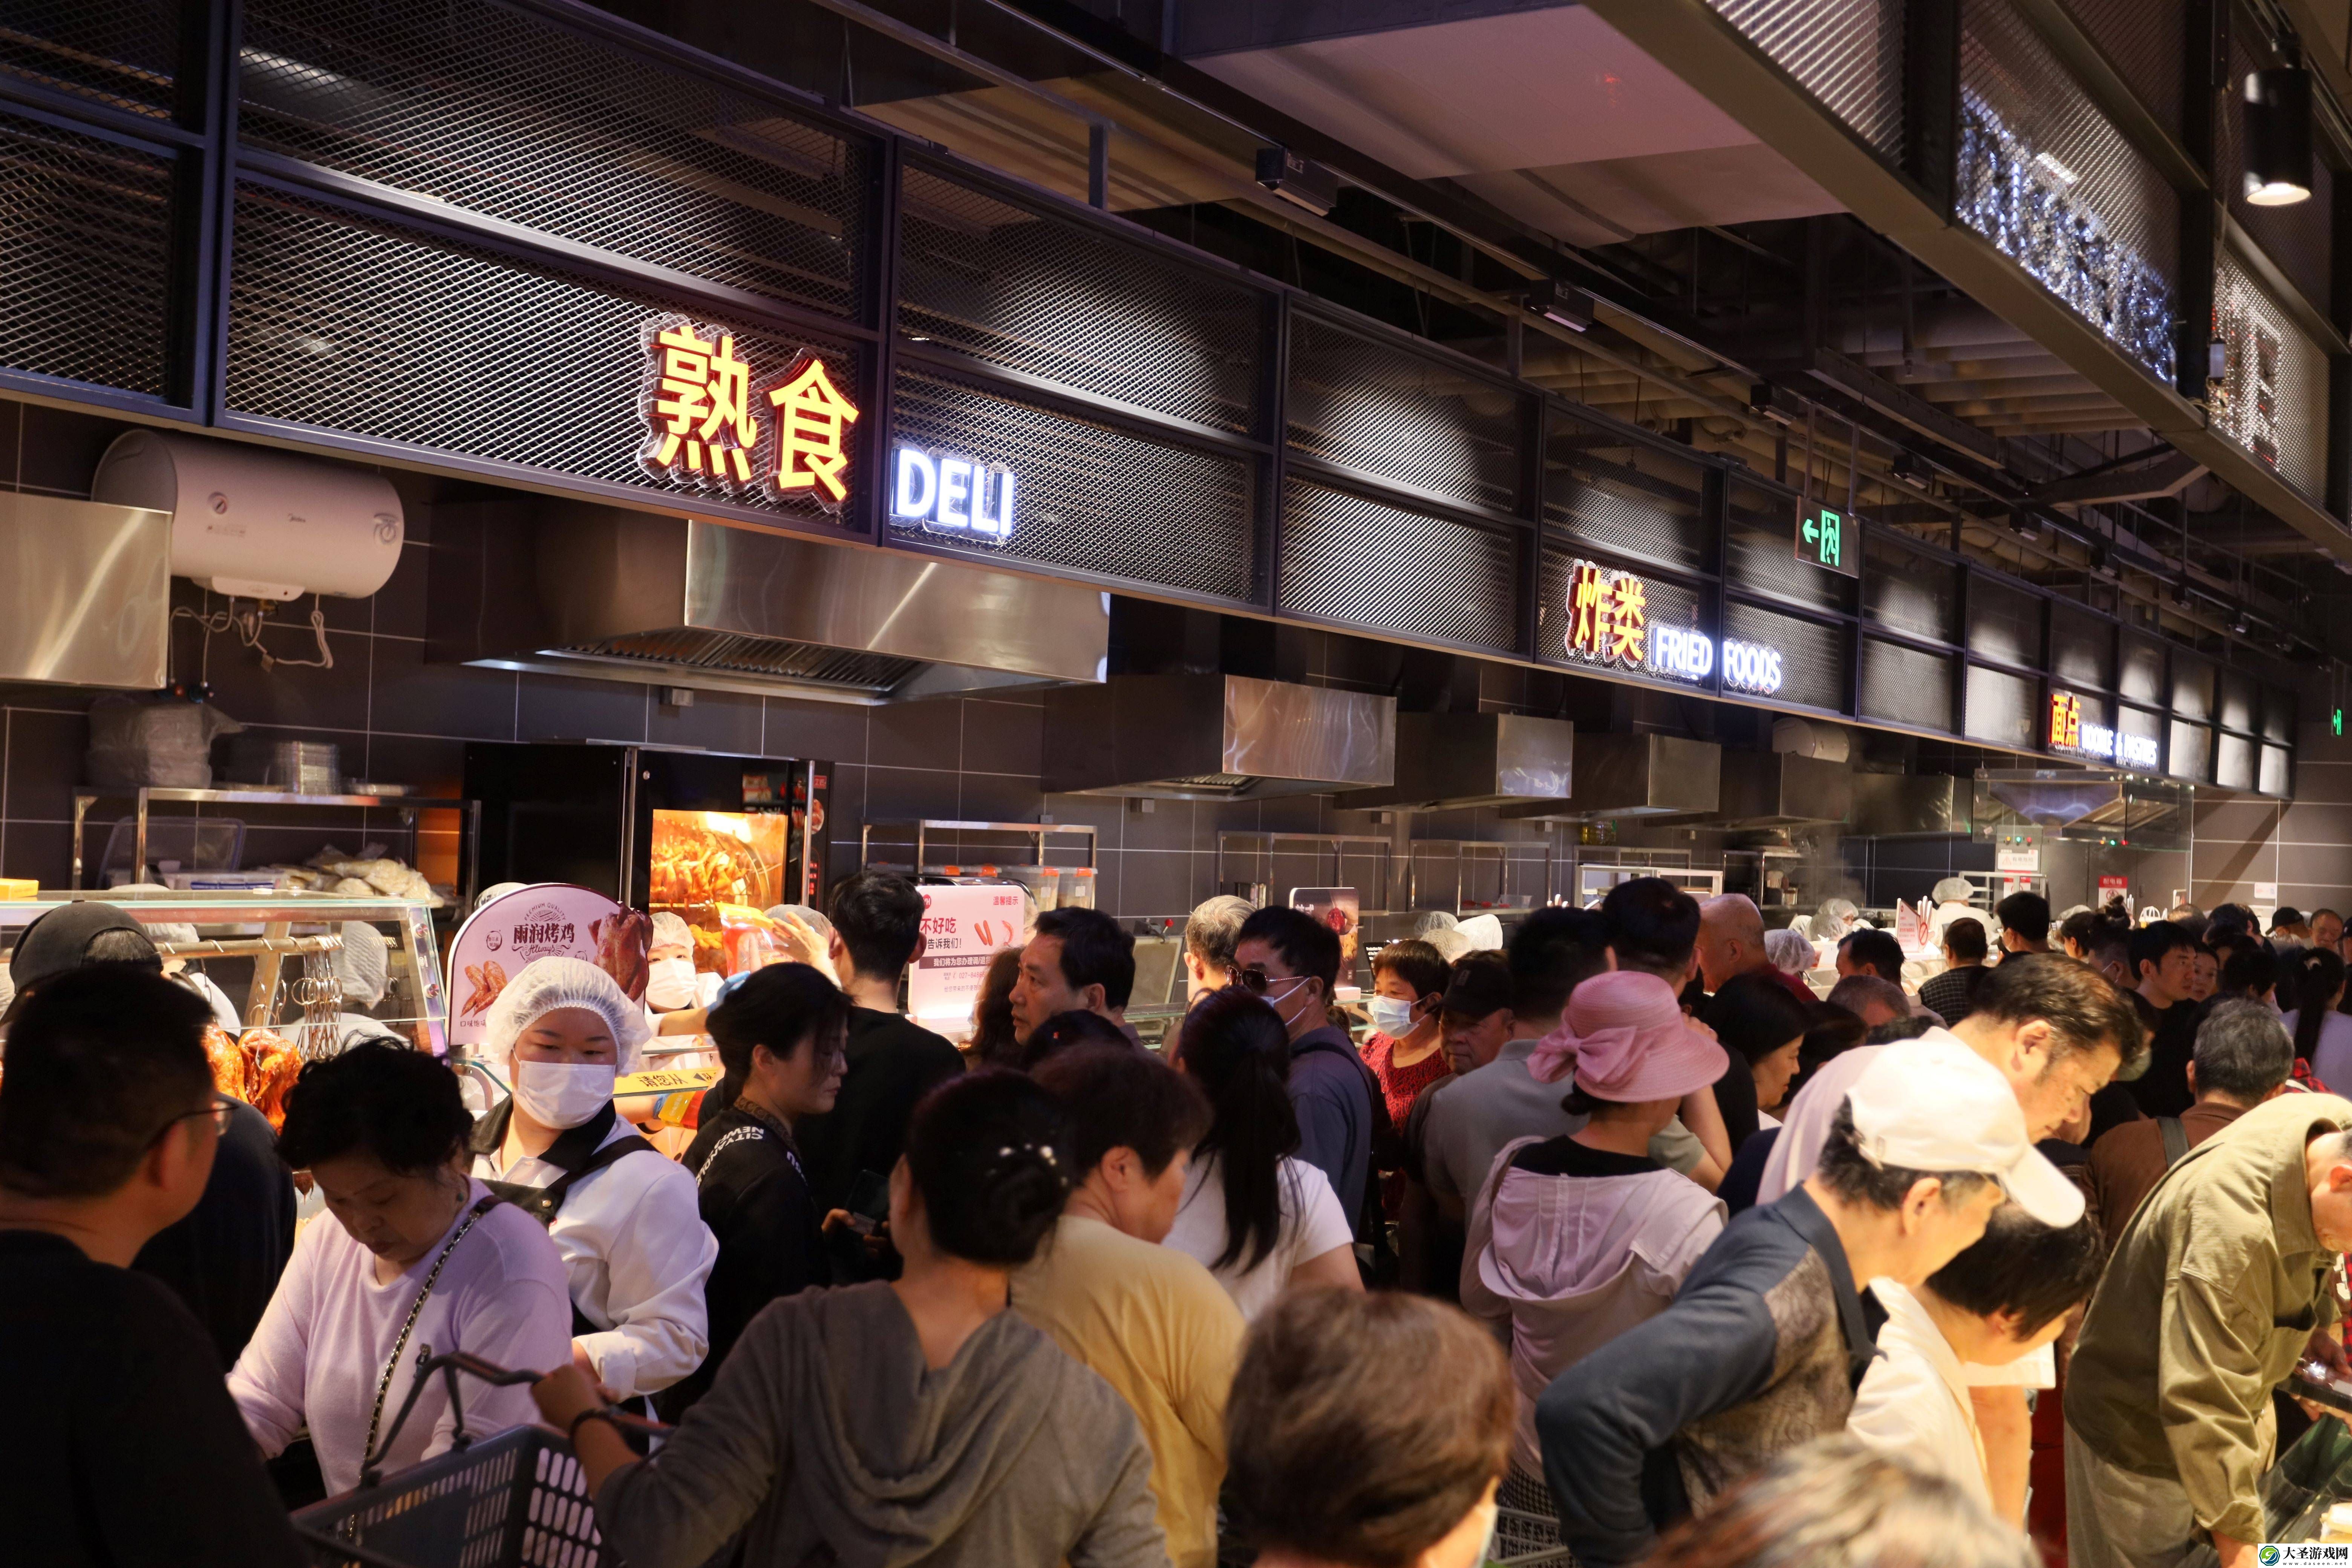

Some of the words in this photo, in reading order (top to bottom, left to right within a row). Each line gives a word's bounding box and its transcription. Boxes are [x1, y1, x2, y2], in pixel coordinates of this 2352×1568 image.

[653, 326, 859, 501] 熟食
[896, 448, 1014, 536] DELI
[1574, 566, 1646, 660] 炸类
[1657, 627, 1713, 677] FRIED
[1723, 641, 1782, 689] FOODS
[2052, 694, 2081, 747] 面点
[524, 902, 545, 921] PREMIUM
[547, 902, 566, 920] QUALITY
[993, 896, 1018, 906] 温馨提示
[514, 923, 574, 944] 雨润烤鸡
[525, 944, 555, 956] Always
[636, 1073, 688, 1087] 请您从
